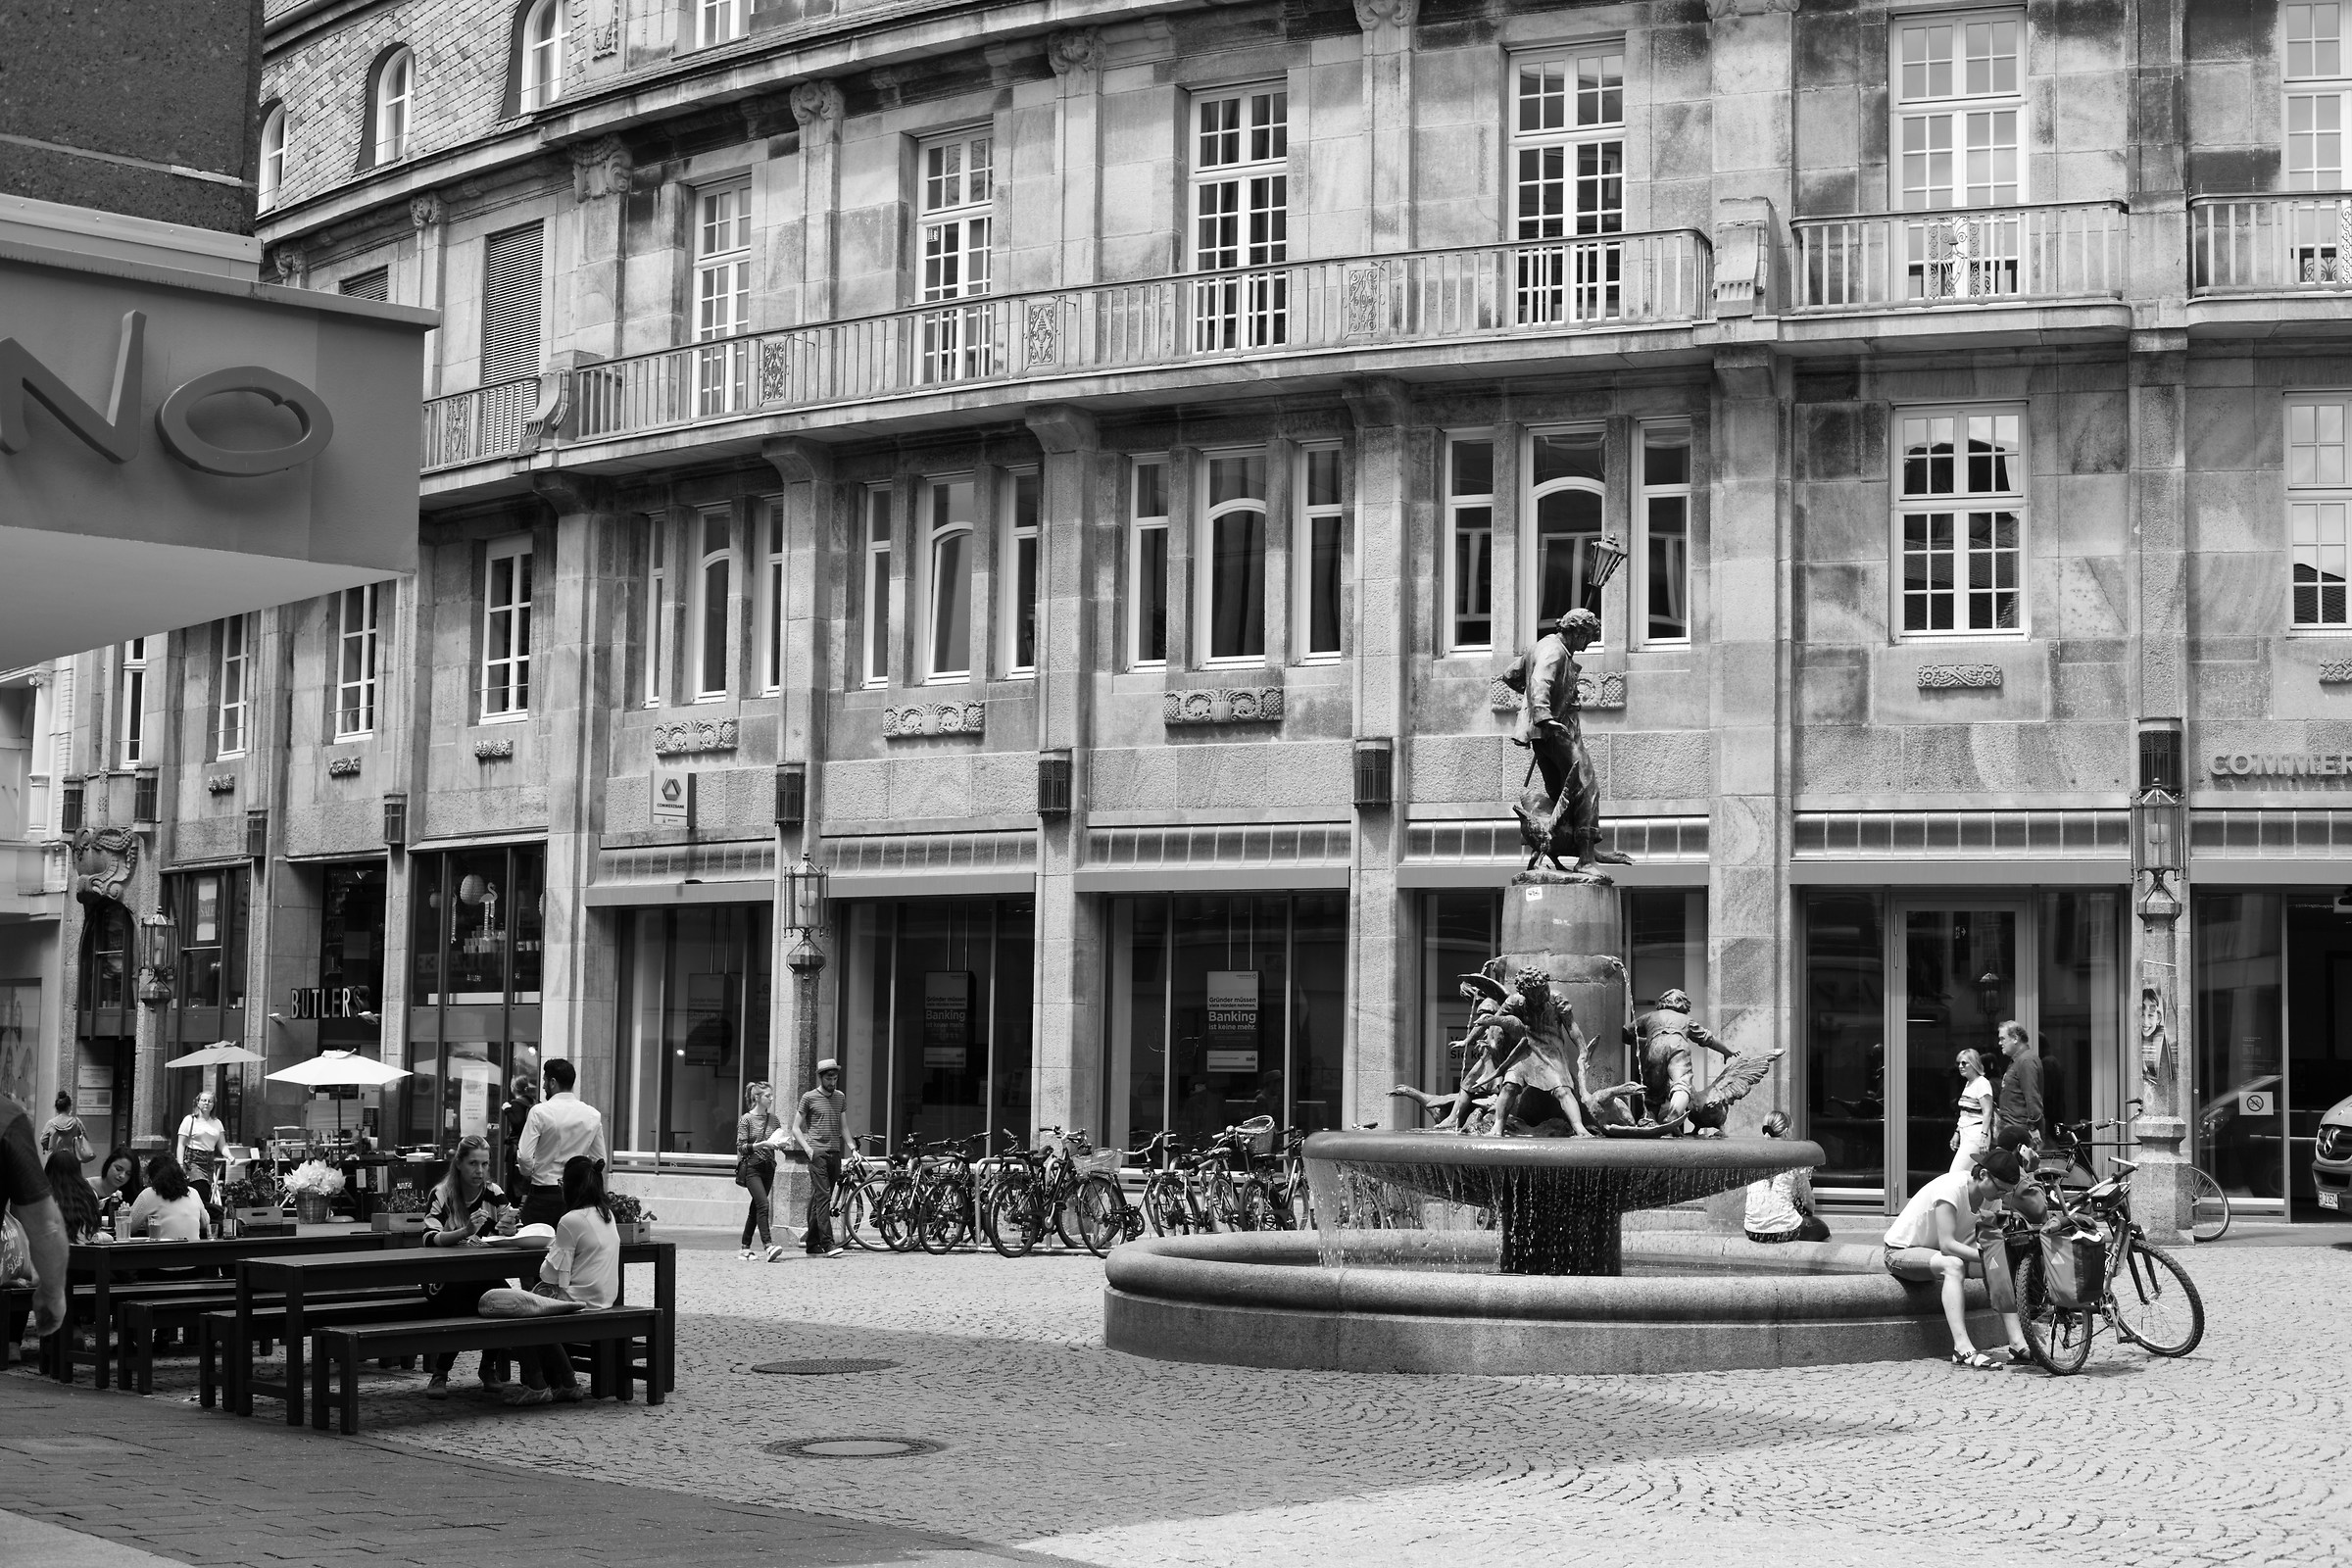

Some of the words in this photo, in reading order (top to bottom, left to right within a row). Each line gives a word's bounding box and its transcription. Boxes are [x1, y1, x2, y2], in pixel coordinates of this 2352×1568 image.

[0, 310, 334, 477] NO
[2208, 752, 2352, 775] COMMER
[291, 987, 367, 1018] BUTLERS
[925, 1010, 966, 1022] Banking
[1208, 1011, 1256, 1024] Banking
[1450, 1050, 1467, 1059] Sie
